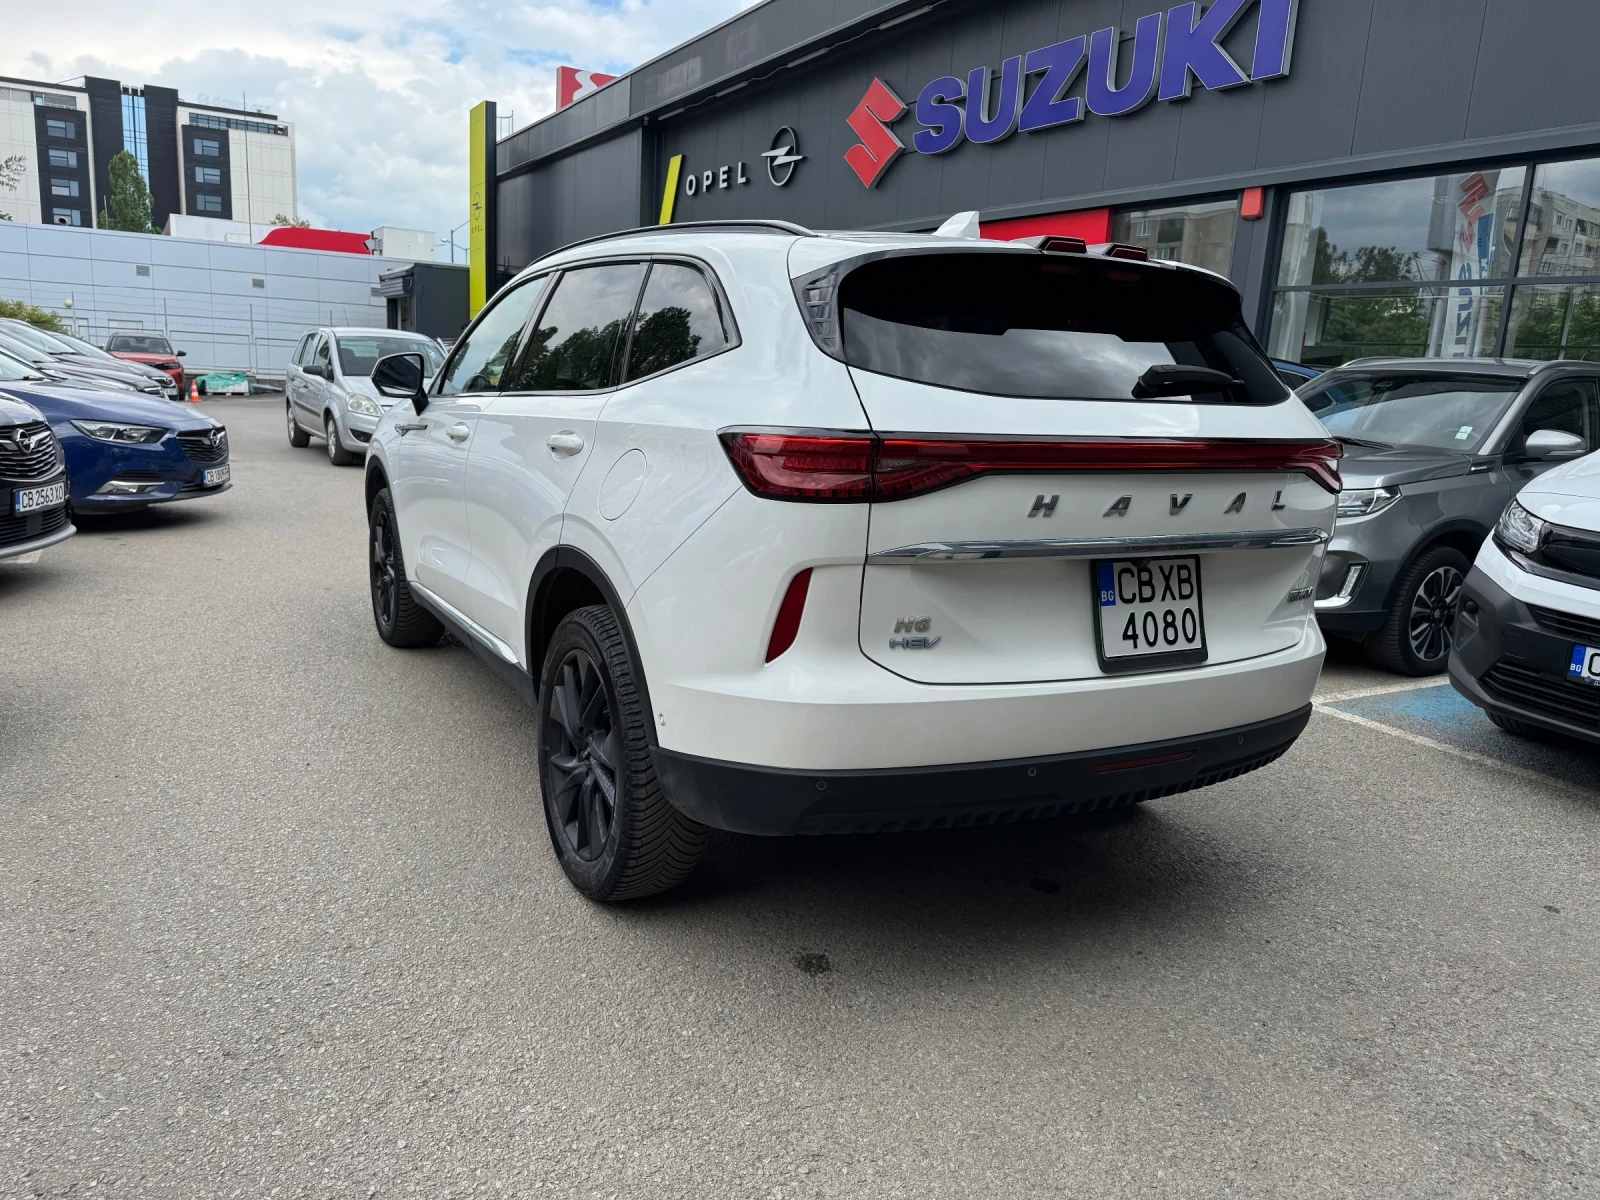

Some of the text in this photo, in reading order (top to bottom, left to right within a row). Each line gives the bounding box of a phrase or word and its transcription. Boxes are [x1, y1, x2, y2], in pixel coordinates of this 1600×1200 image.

[912, 0, 1297, 155] SUZUKI
[685, 161, 747, 196] OPEL
[21, 491, 34, 508] CB
[35, 487, 54, 506] 2563
[54, 485, 64, 502] XO
[1027, 490, 1286, 518] HAVAL
[1101, 590, 1114, 602] BG
[893, 616, 931, 633] H6
[1122, 607, 1197, 649] 4080
[889, 636, 941, 649] HEV
[1570, 663, 1582, 672] BG
